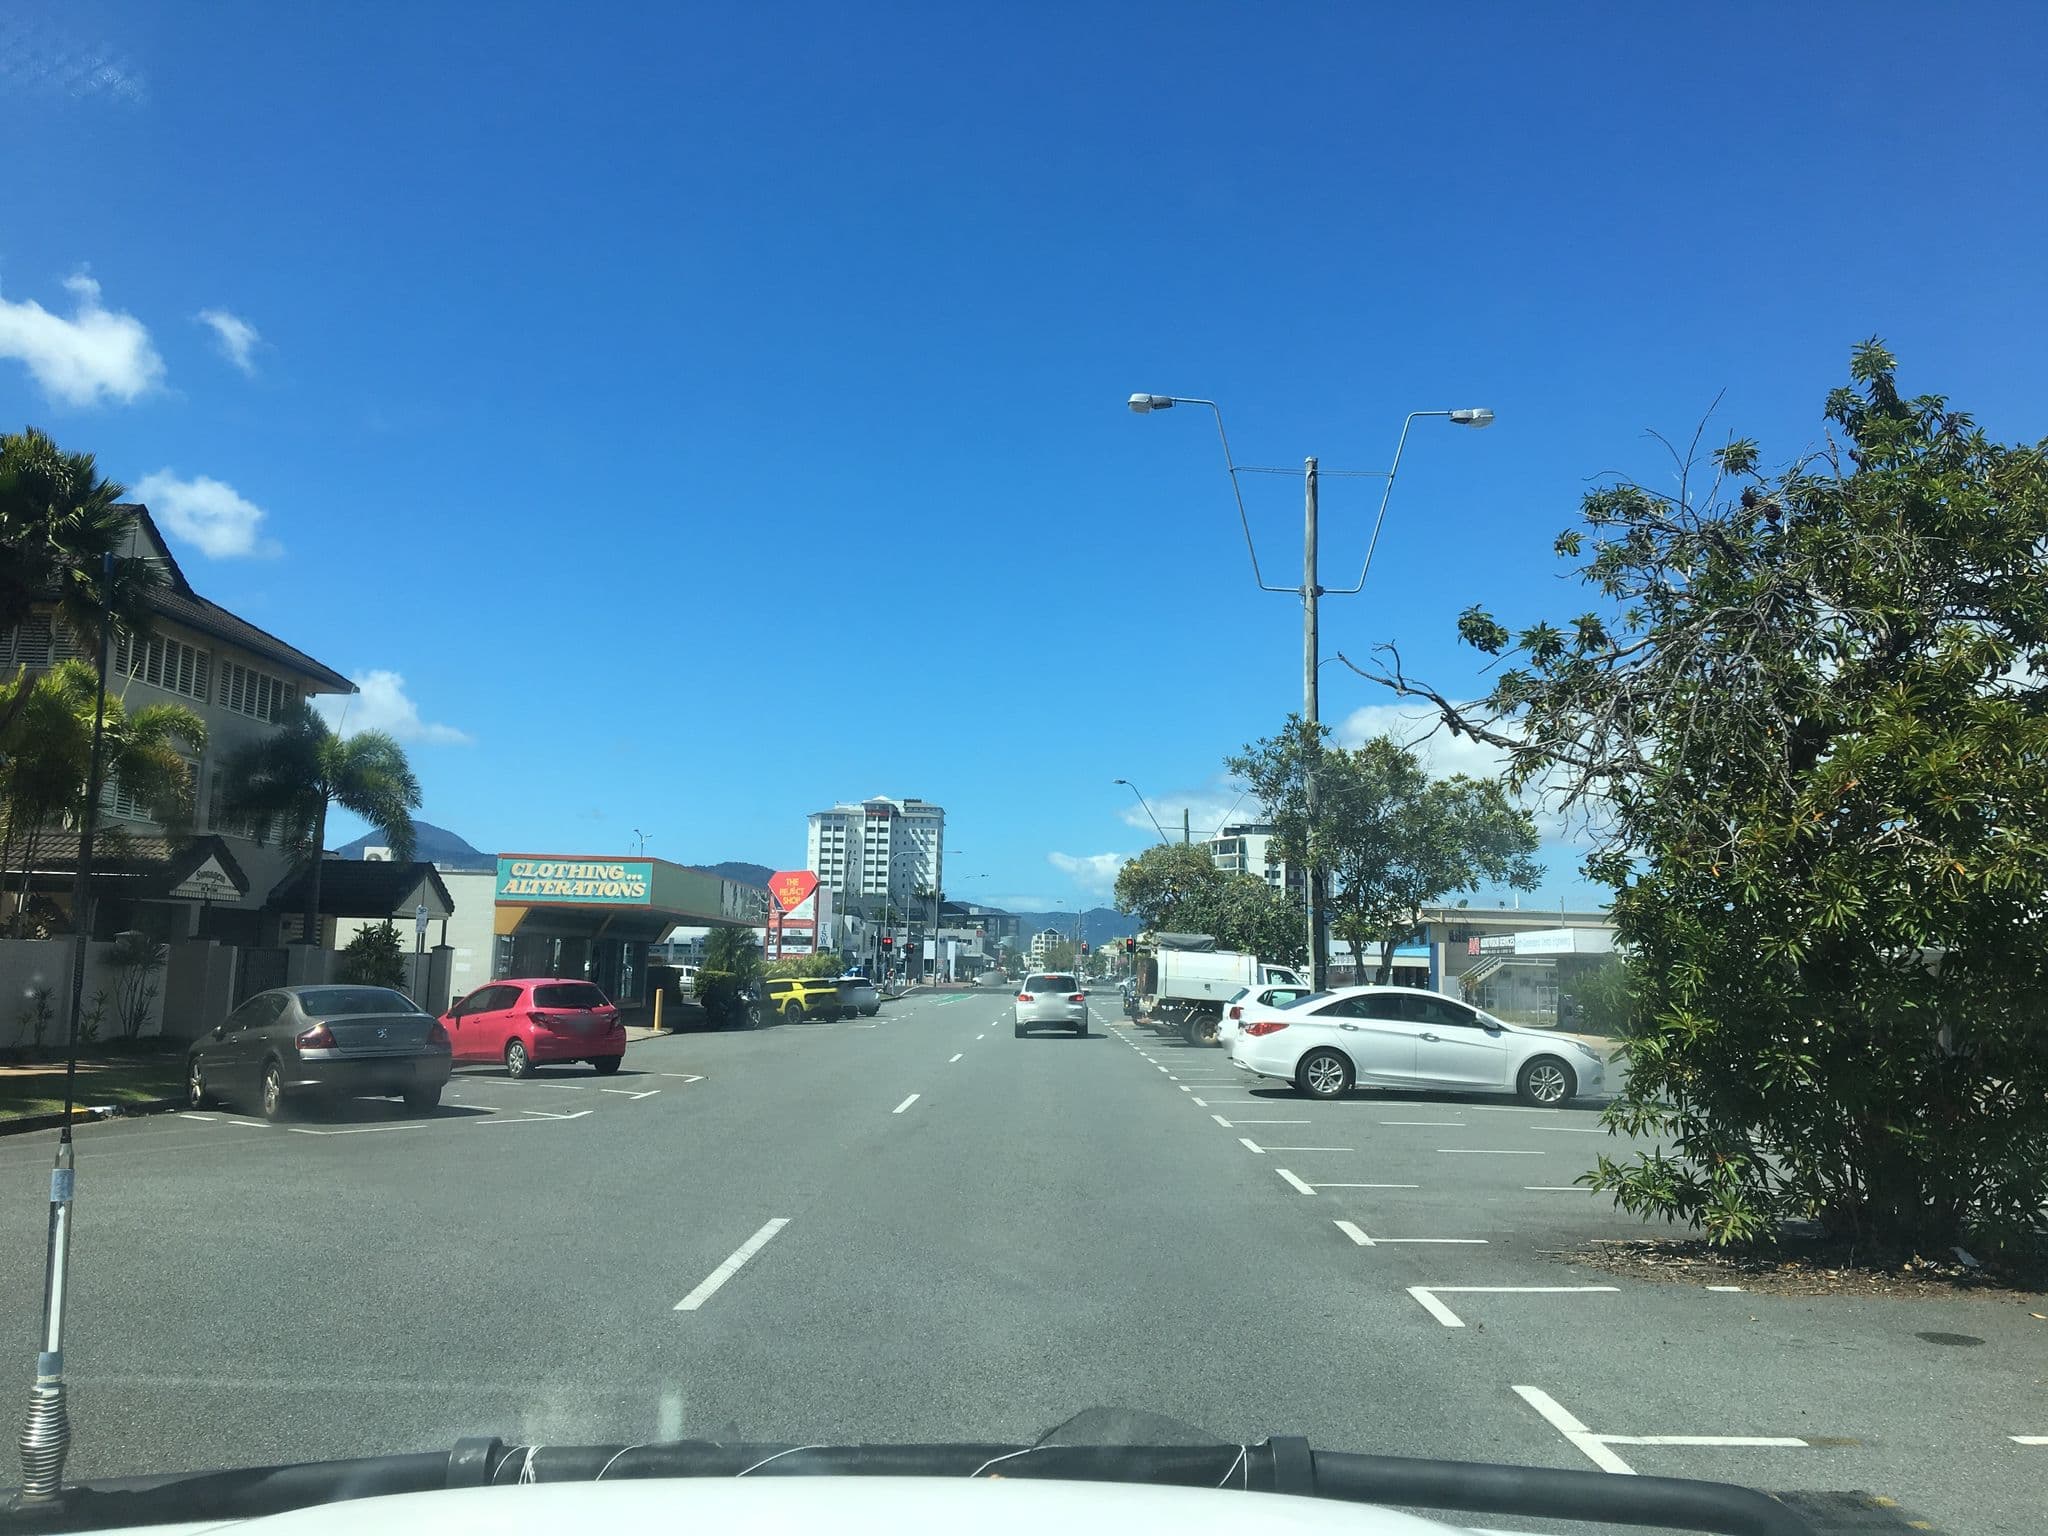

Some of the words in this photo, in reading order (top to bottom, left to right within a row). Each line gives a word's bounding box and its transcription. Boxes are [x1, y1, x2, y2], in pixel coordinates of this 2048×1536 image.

[786, 878, 800, 886] THE
[499, 879, 646, 897] ALTERATIONS
[779, 887, 805, 896] REJECT
[782, 896, 801, 904] SHOP
